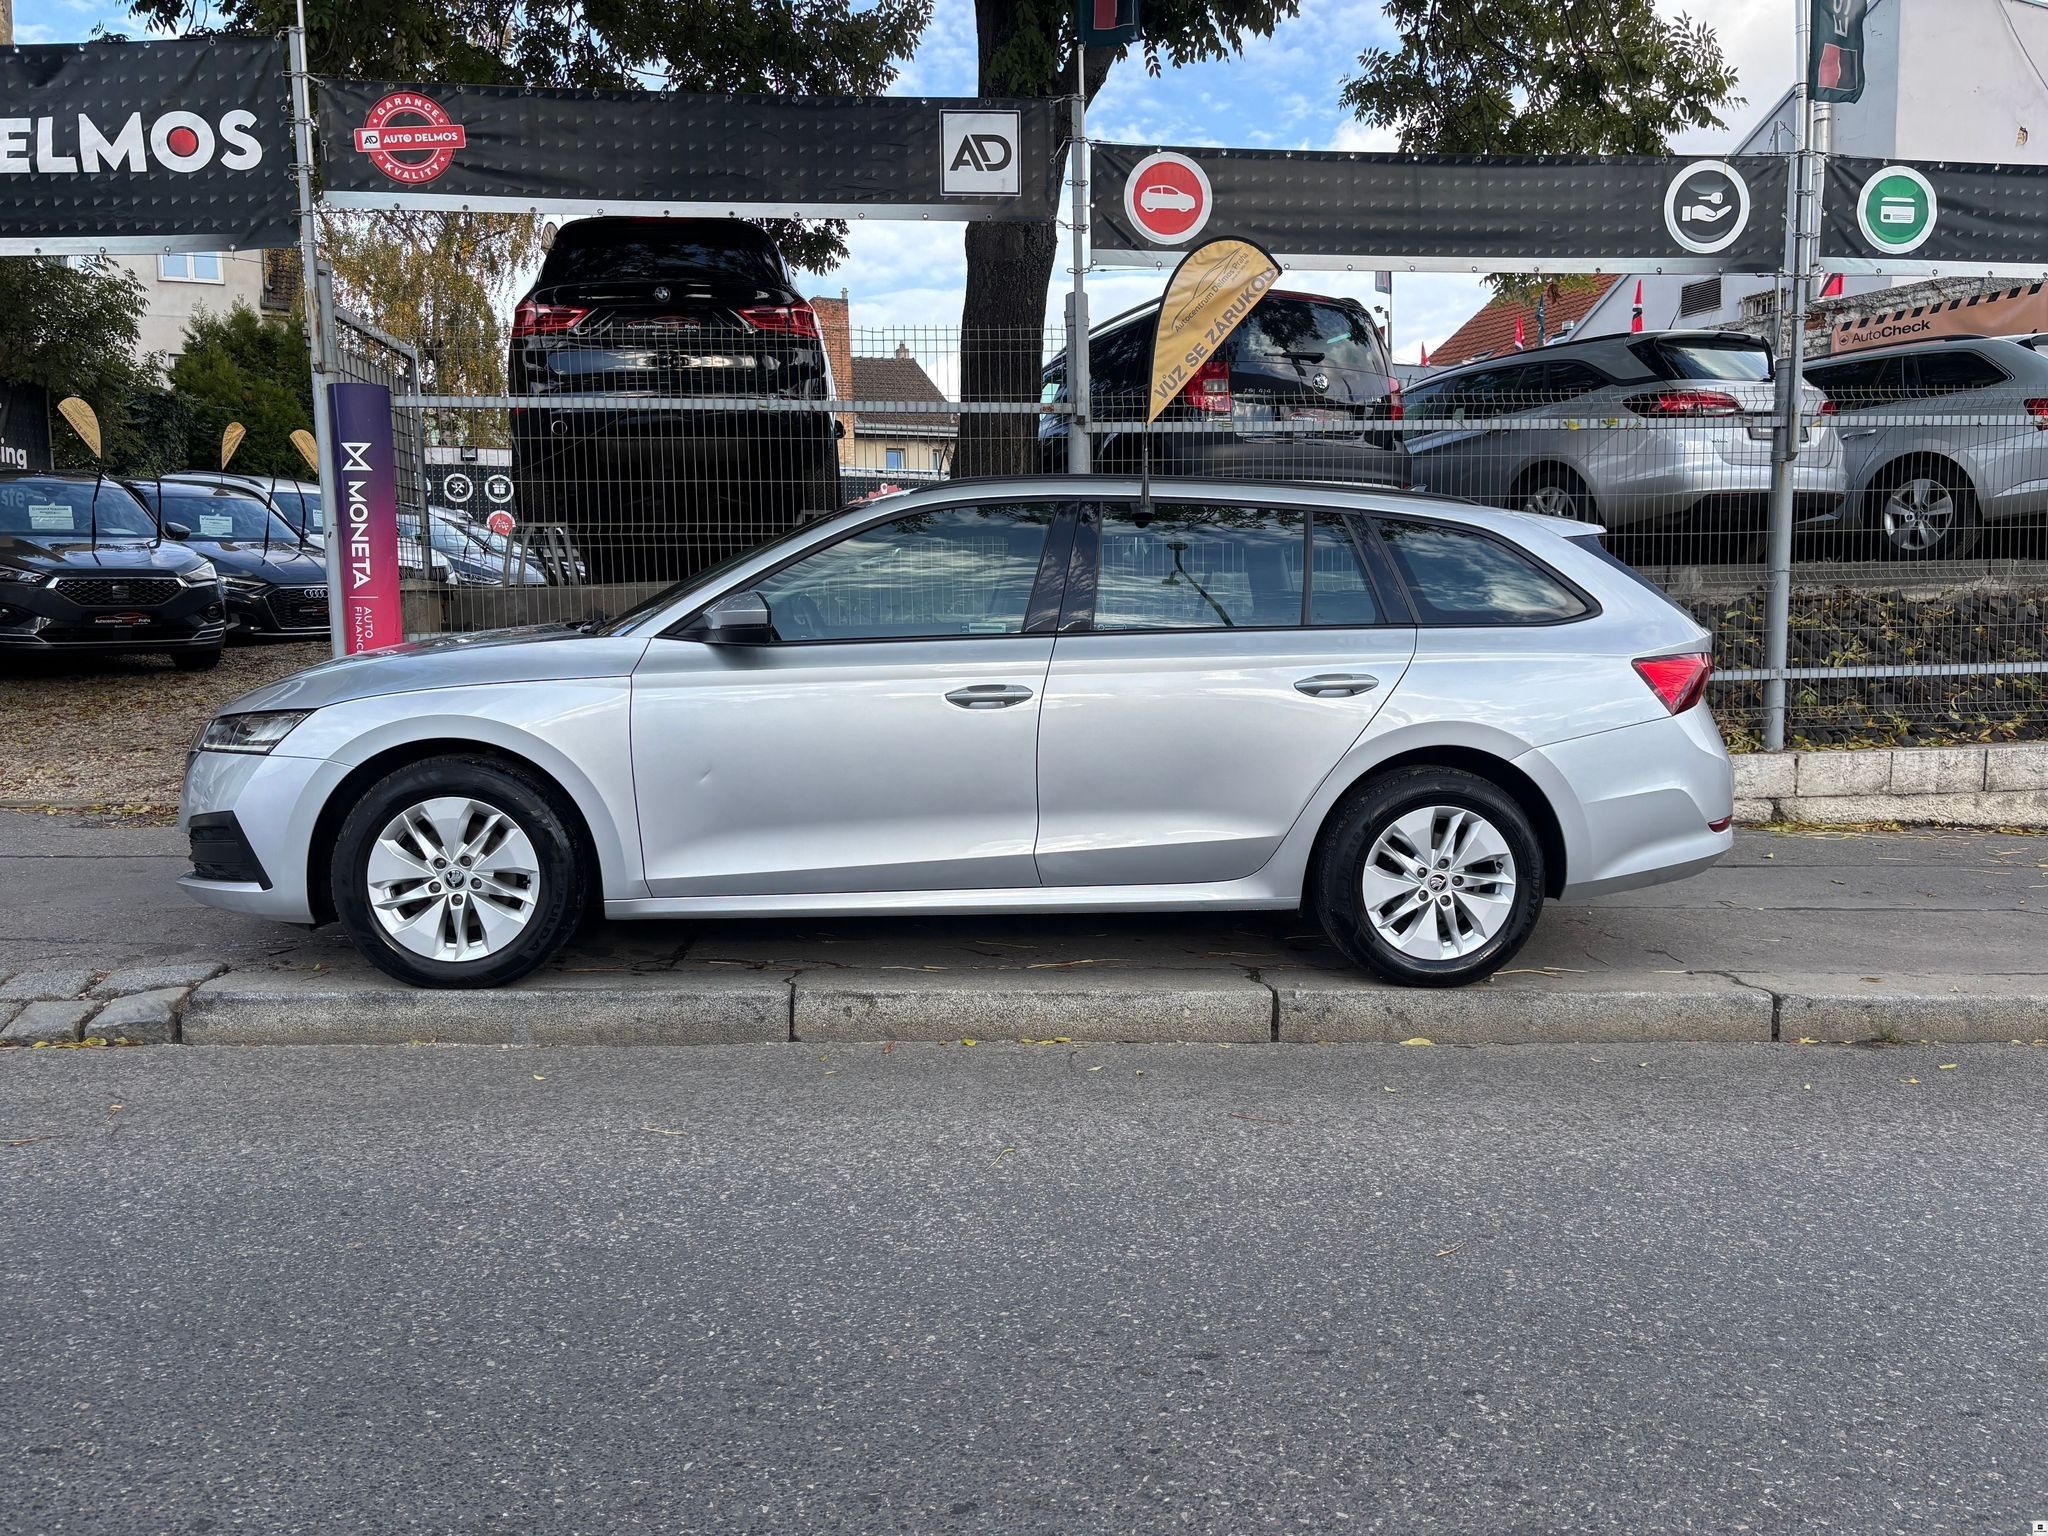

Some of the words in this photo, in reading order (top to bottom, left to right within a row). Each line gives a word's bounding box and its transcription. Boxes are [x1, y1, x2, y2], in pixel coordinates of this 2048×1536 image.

[377, 96, 440, 118] GARANCE
[0, 109, 263, 173] ELMOS
[383, 134, 412, 144] AUTO
[414, 132, 458, 142] DELMOS
[949, 134, 1012, 171] AD
[384, 162, 440, 179] KVALITY
[1175, 292, 1214, 333] Autocentrum
[1233, 252, 1249, 271] Praha
[1154, 365, 1187, 399] VŮZ
[1185, 343, 1209, 368] SE
[1205, 267, 1276, 345] ZÁRUKOU
[1852, 320, 1931, 343] AutoCheck
[0, 437, 27, 469] ing
[349, 481, 371, 589] MONETA
[364, 606, 374, 639] AUTO
